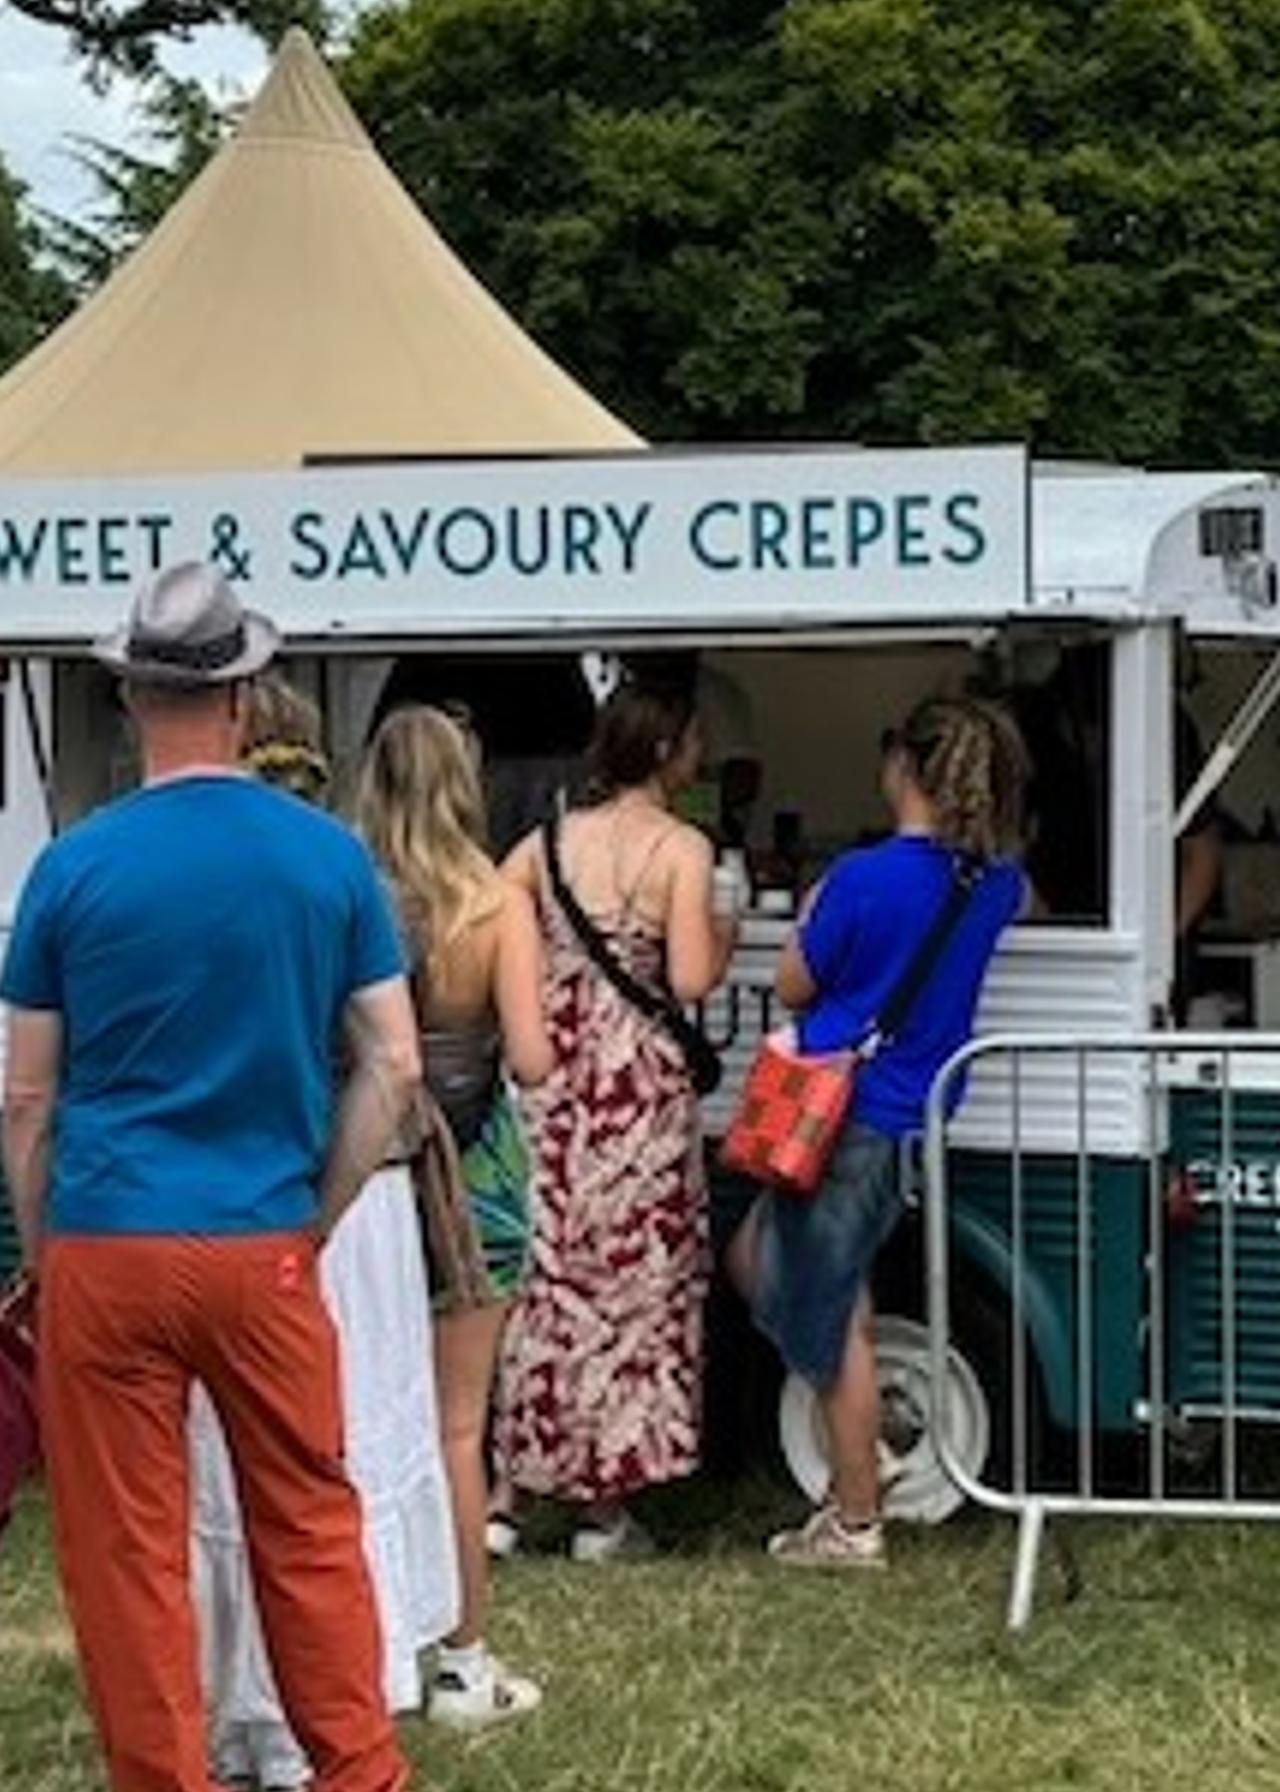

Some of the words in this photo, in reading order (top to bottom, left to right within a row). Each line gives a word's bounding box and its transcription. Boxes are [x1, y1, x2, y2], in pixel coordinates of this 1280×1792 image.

[209, 512, 251, 582] &
[288, 501, 652, 580] SAVOURY
[688, 494, 987, 571] CREPES
